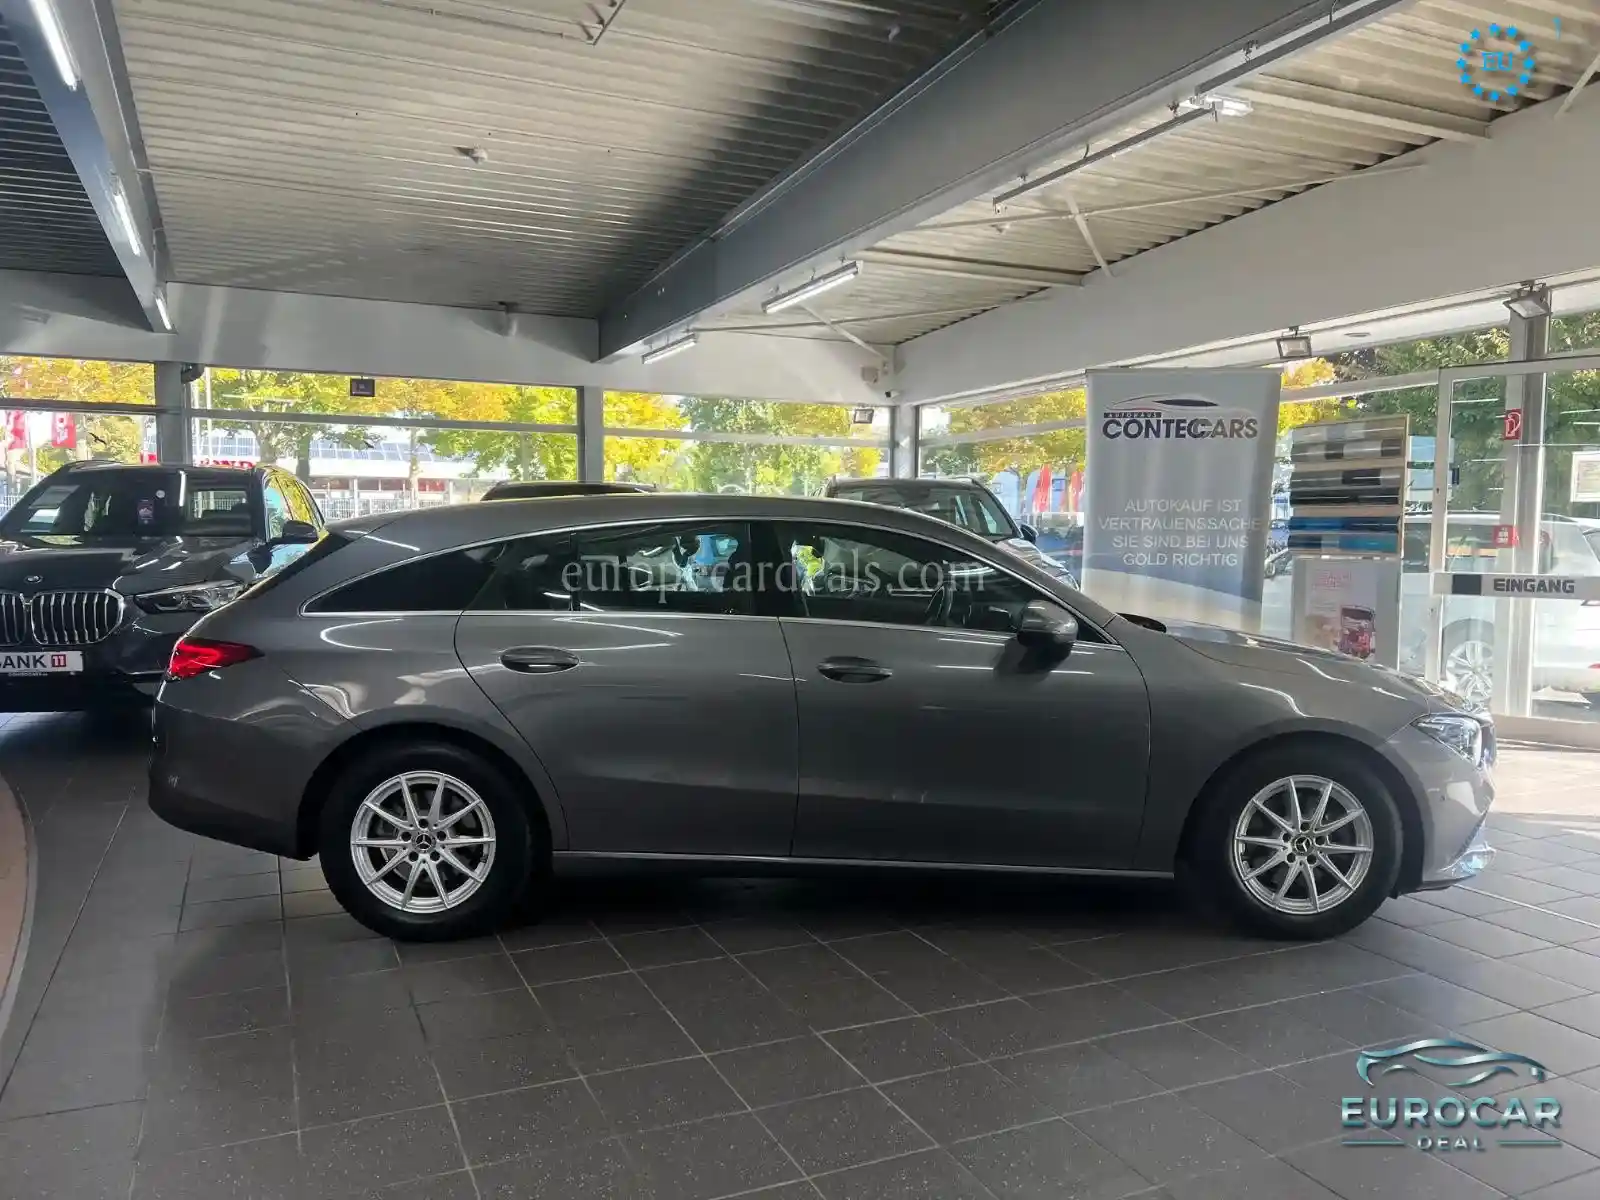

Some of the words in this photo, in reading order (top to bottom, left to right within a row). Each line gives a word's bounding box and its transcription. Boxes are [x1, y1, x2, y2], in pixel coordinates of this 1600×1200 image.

[1124, 499, 1213, 512] AUTOKAUF
[1217, 500, 1242, 512] IST
[1099, 517, 1261, 530] VERTRAUENSSACHE
[1112, 535, 1138, 548] SIE
[1143, 535, 1180, 548] SIND
[1185, 535, 1211, 548] BEI
[1216, 535, 1249, 548] UNS
[1122, 553, 1168, 566] GOLD
[1172, 553, 1238, 566] RICHTIG
[1493, 578, 1575, 594] EINGANG
[0, 654, 47, 669] ANK
